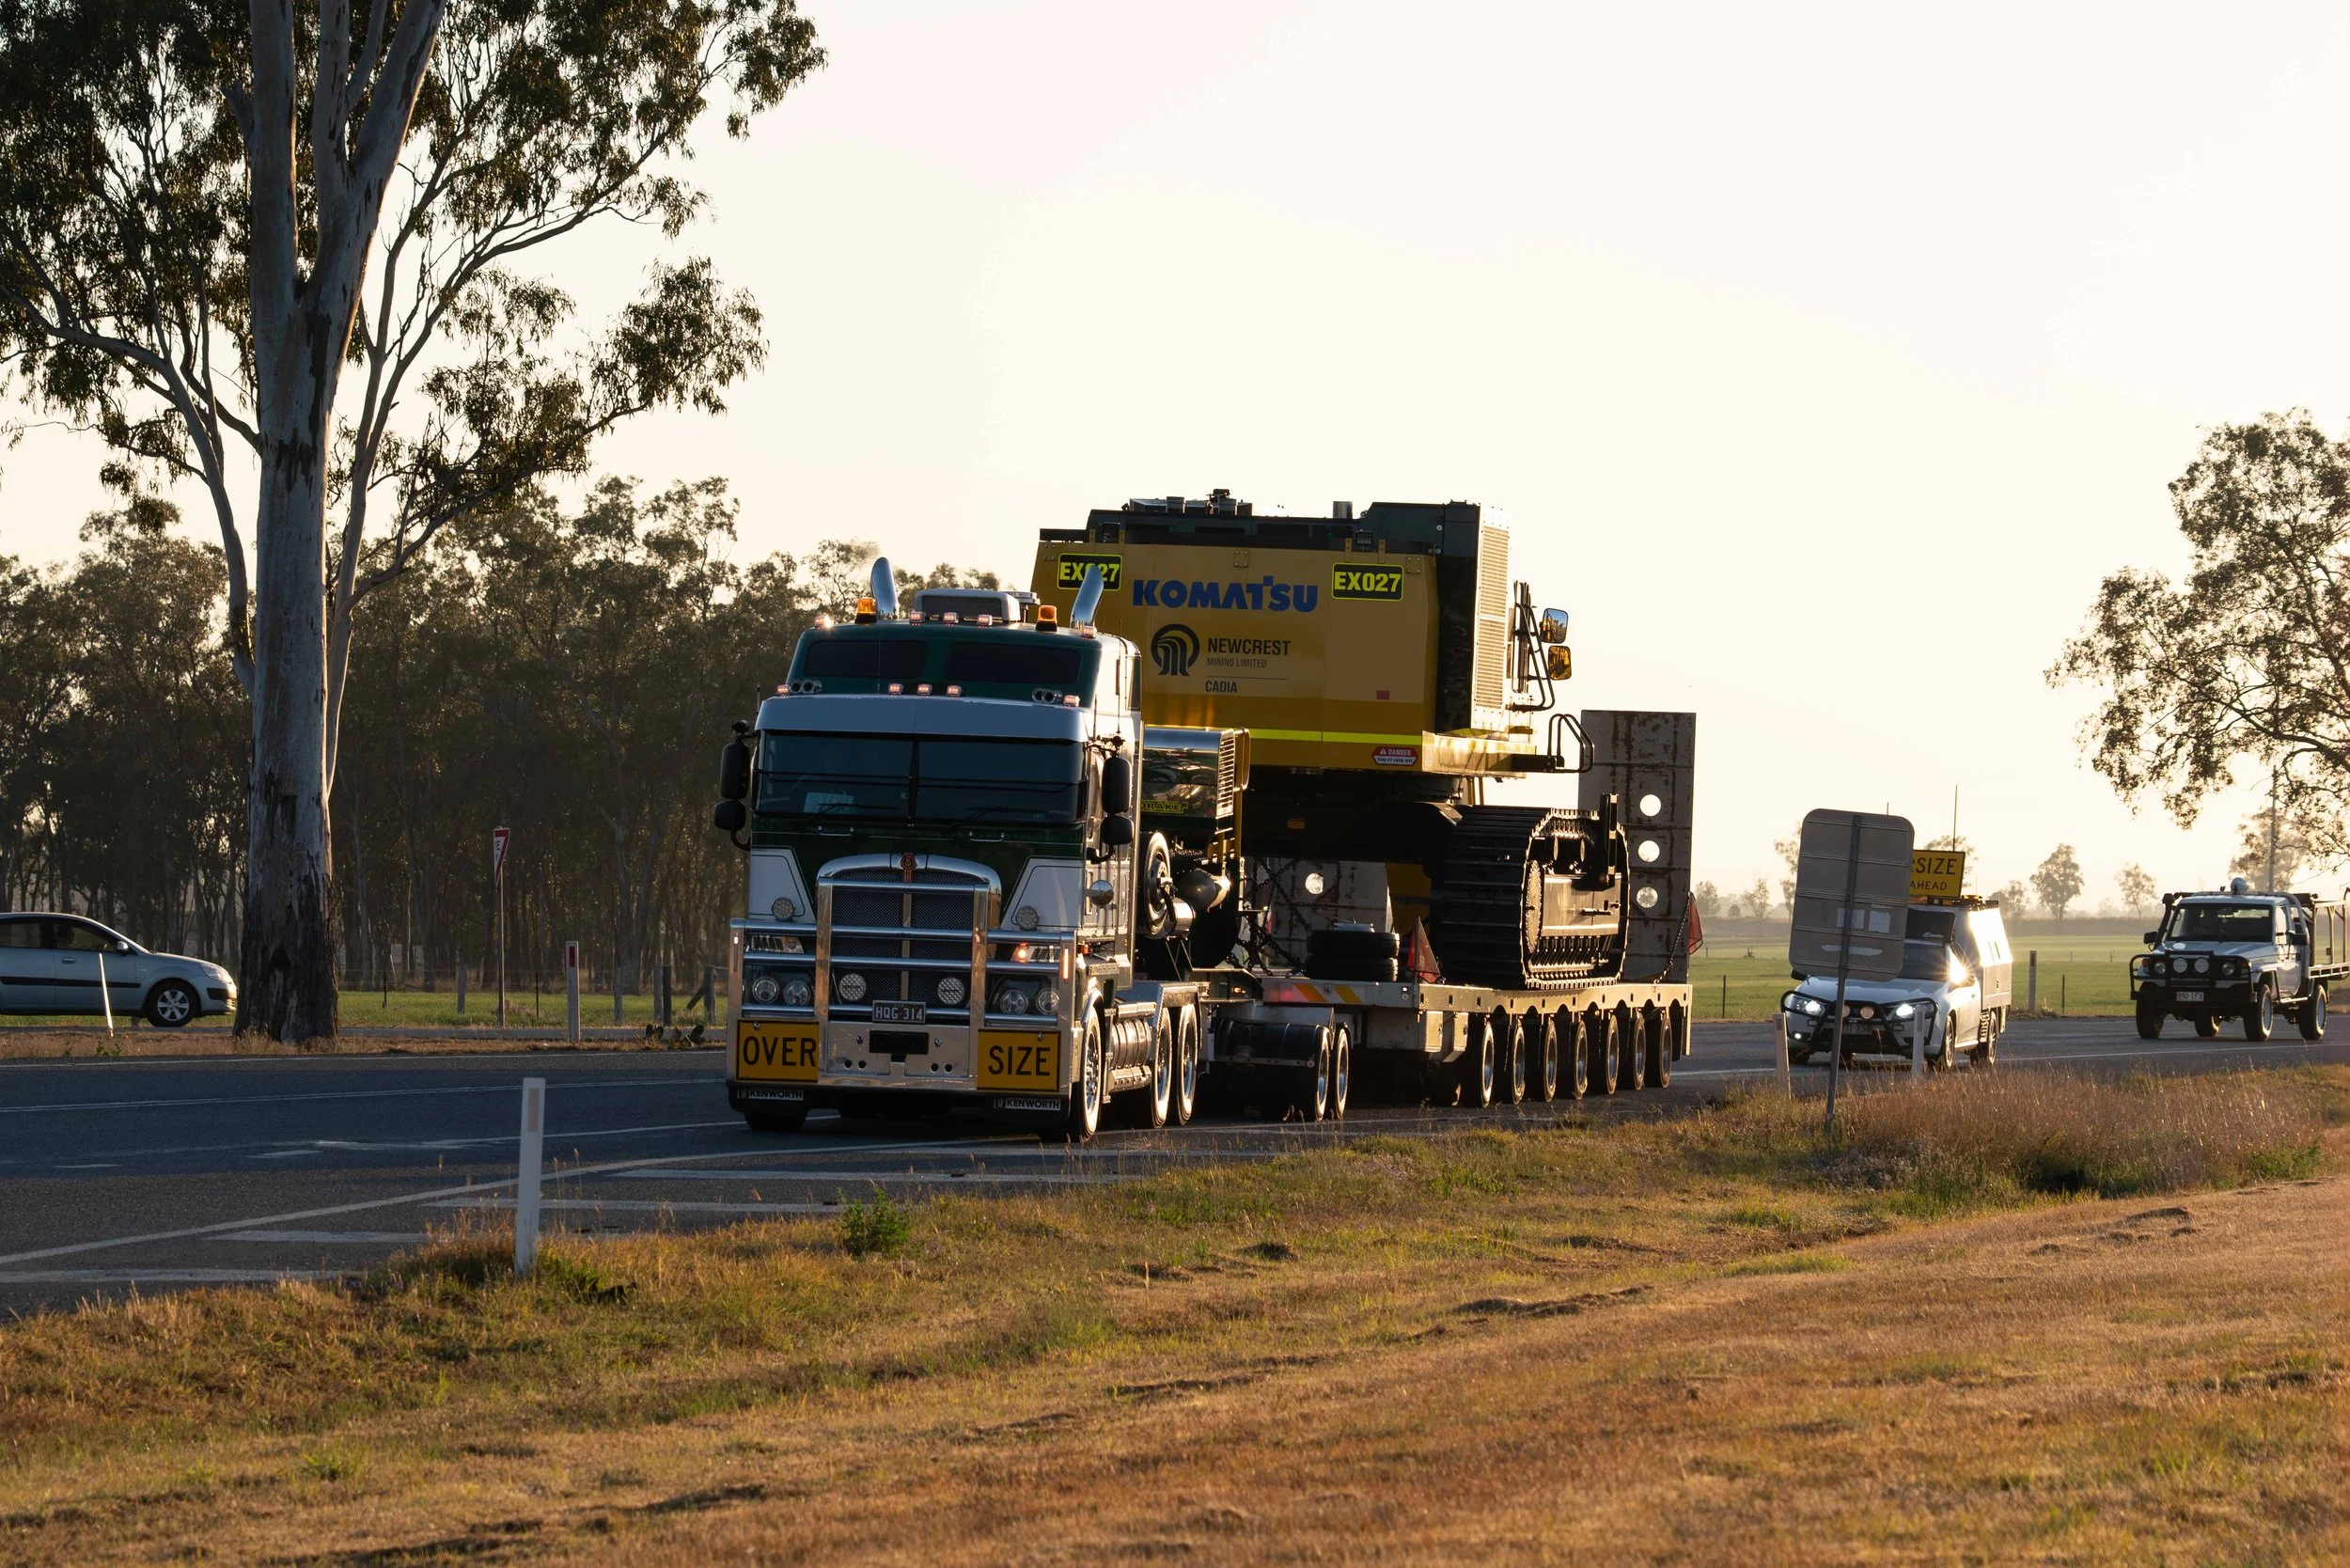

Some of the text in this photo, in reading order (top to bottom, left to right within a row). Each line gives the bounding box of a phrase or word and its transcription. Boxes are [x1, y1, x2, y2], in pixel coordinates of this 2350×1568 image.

[1334, 572, 1402, 592] EX027
[1133, 575, 1318, 613] KOMATSU
[1207, 637, 1291, 656] NEWCREST
[1207, 657, 1267, 668] MINING LIMITED
[1205, 681, 1237, 694] CADIA
[1387, 748, 1412, 757] DANGER
[743, 1036, 1051, 1076] OVER SIZE
[750, 1090, 803, 1100] KENWORTH
[1006, 1098, 1059, 1109] KENWORTH
